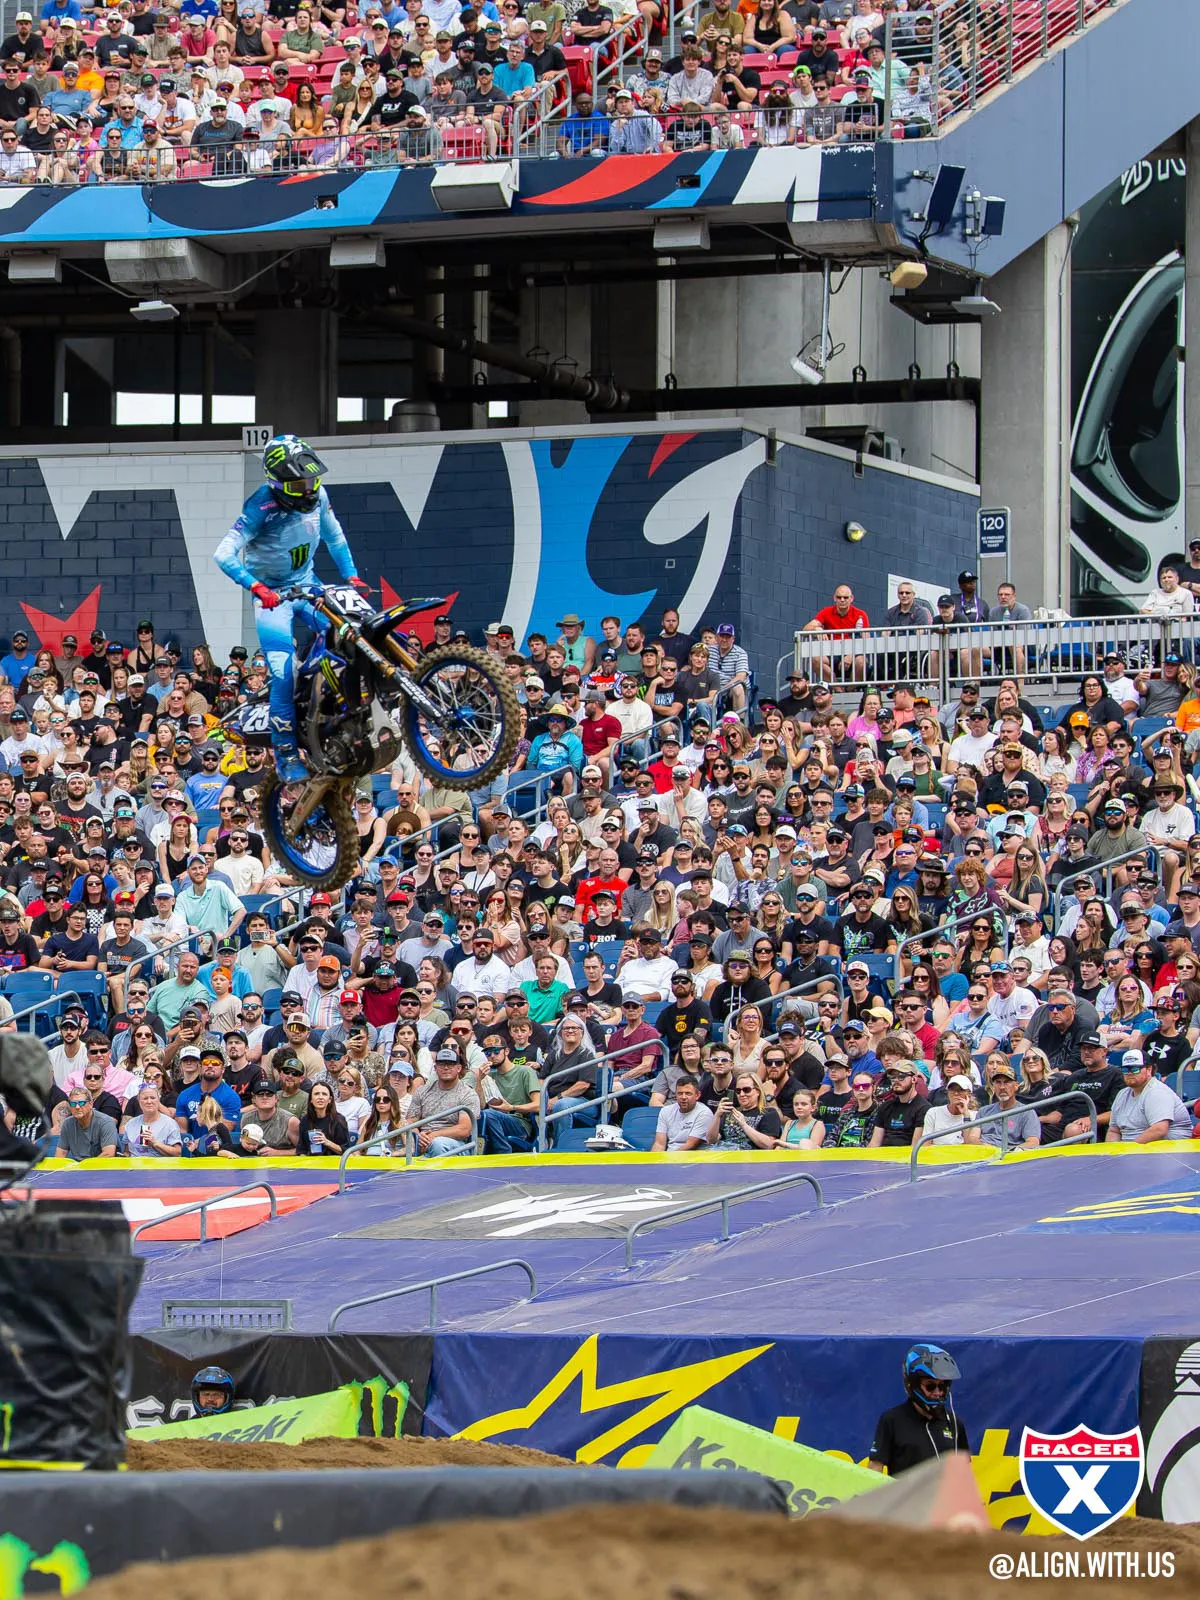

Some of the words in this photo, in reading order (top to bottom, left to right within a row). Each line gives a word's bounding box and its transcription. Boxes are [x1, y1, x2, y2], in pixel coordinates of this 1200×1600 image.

[381, 102, 402, 112] FLY
[246, 430, 270, 446] 119
[981, 516, 1005, 530] 120
[335, 588, 372, 612] 25
[242, 704, 270, 732] 25
[597, 933, 618, 942] HOT
